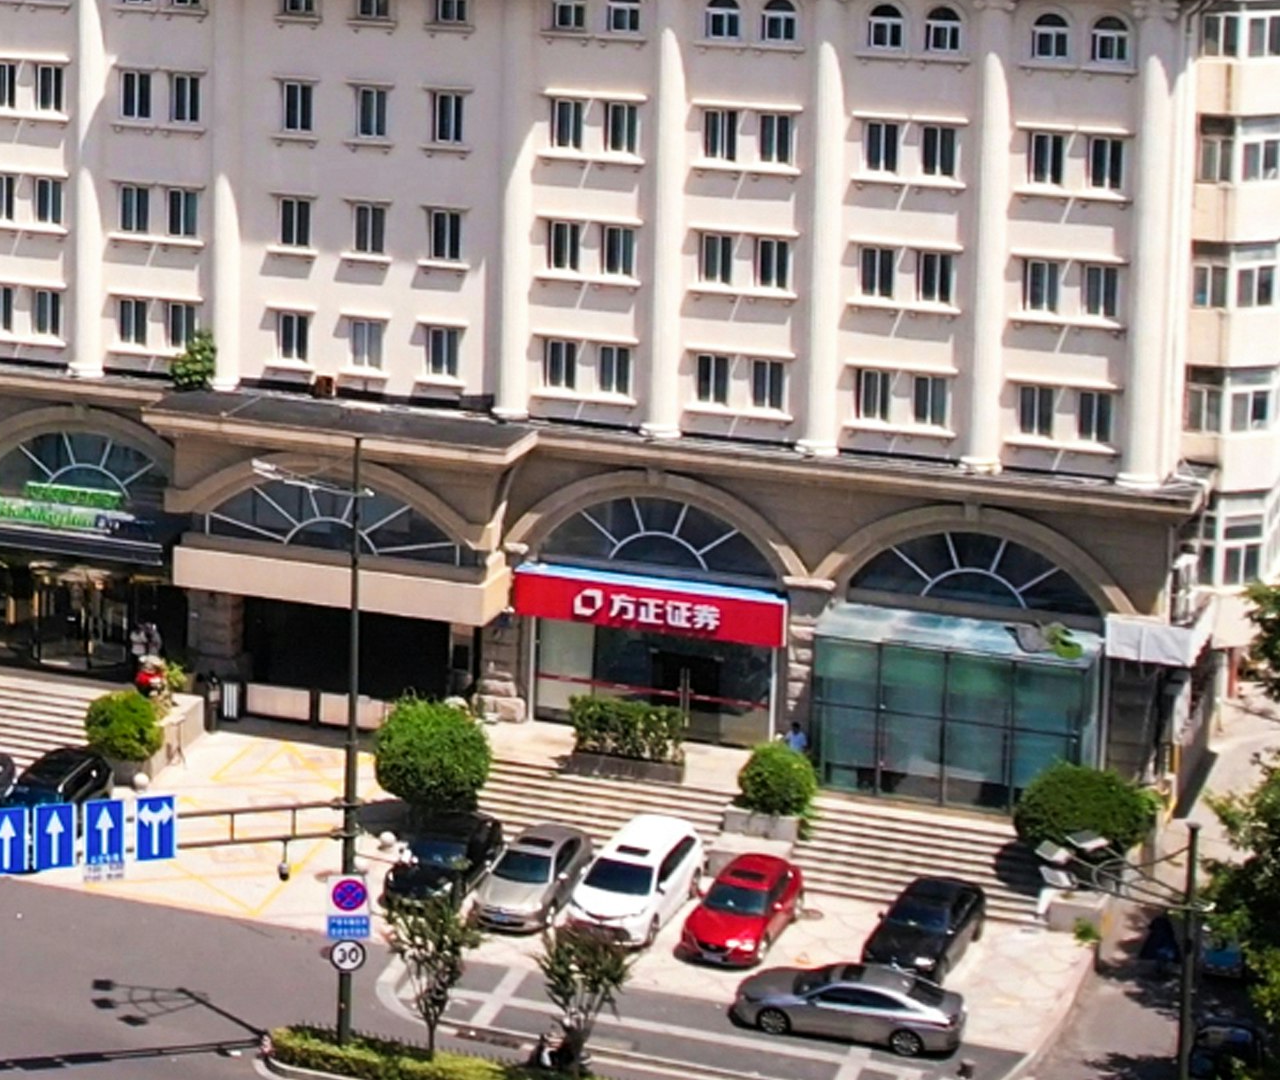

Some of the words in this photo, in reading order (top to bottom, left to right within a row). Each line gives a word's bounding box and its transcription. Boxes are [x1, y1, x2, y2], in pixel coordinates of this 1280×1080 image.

[609, 593, 720, 631] 方正证券
[337, 947, 359, 964] 30
